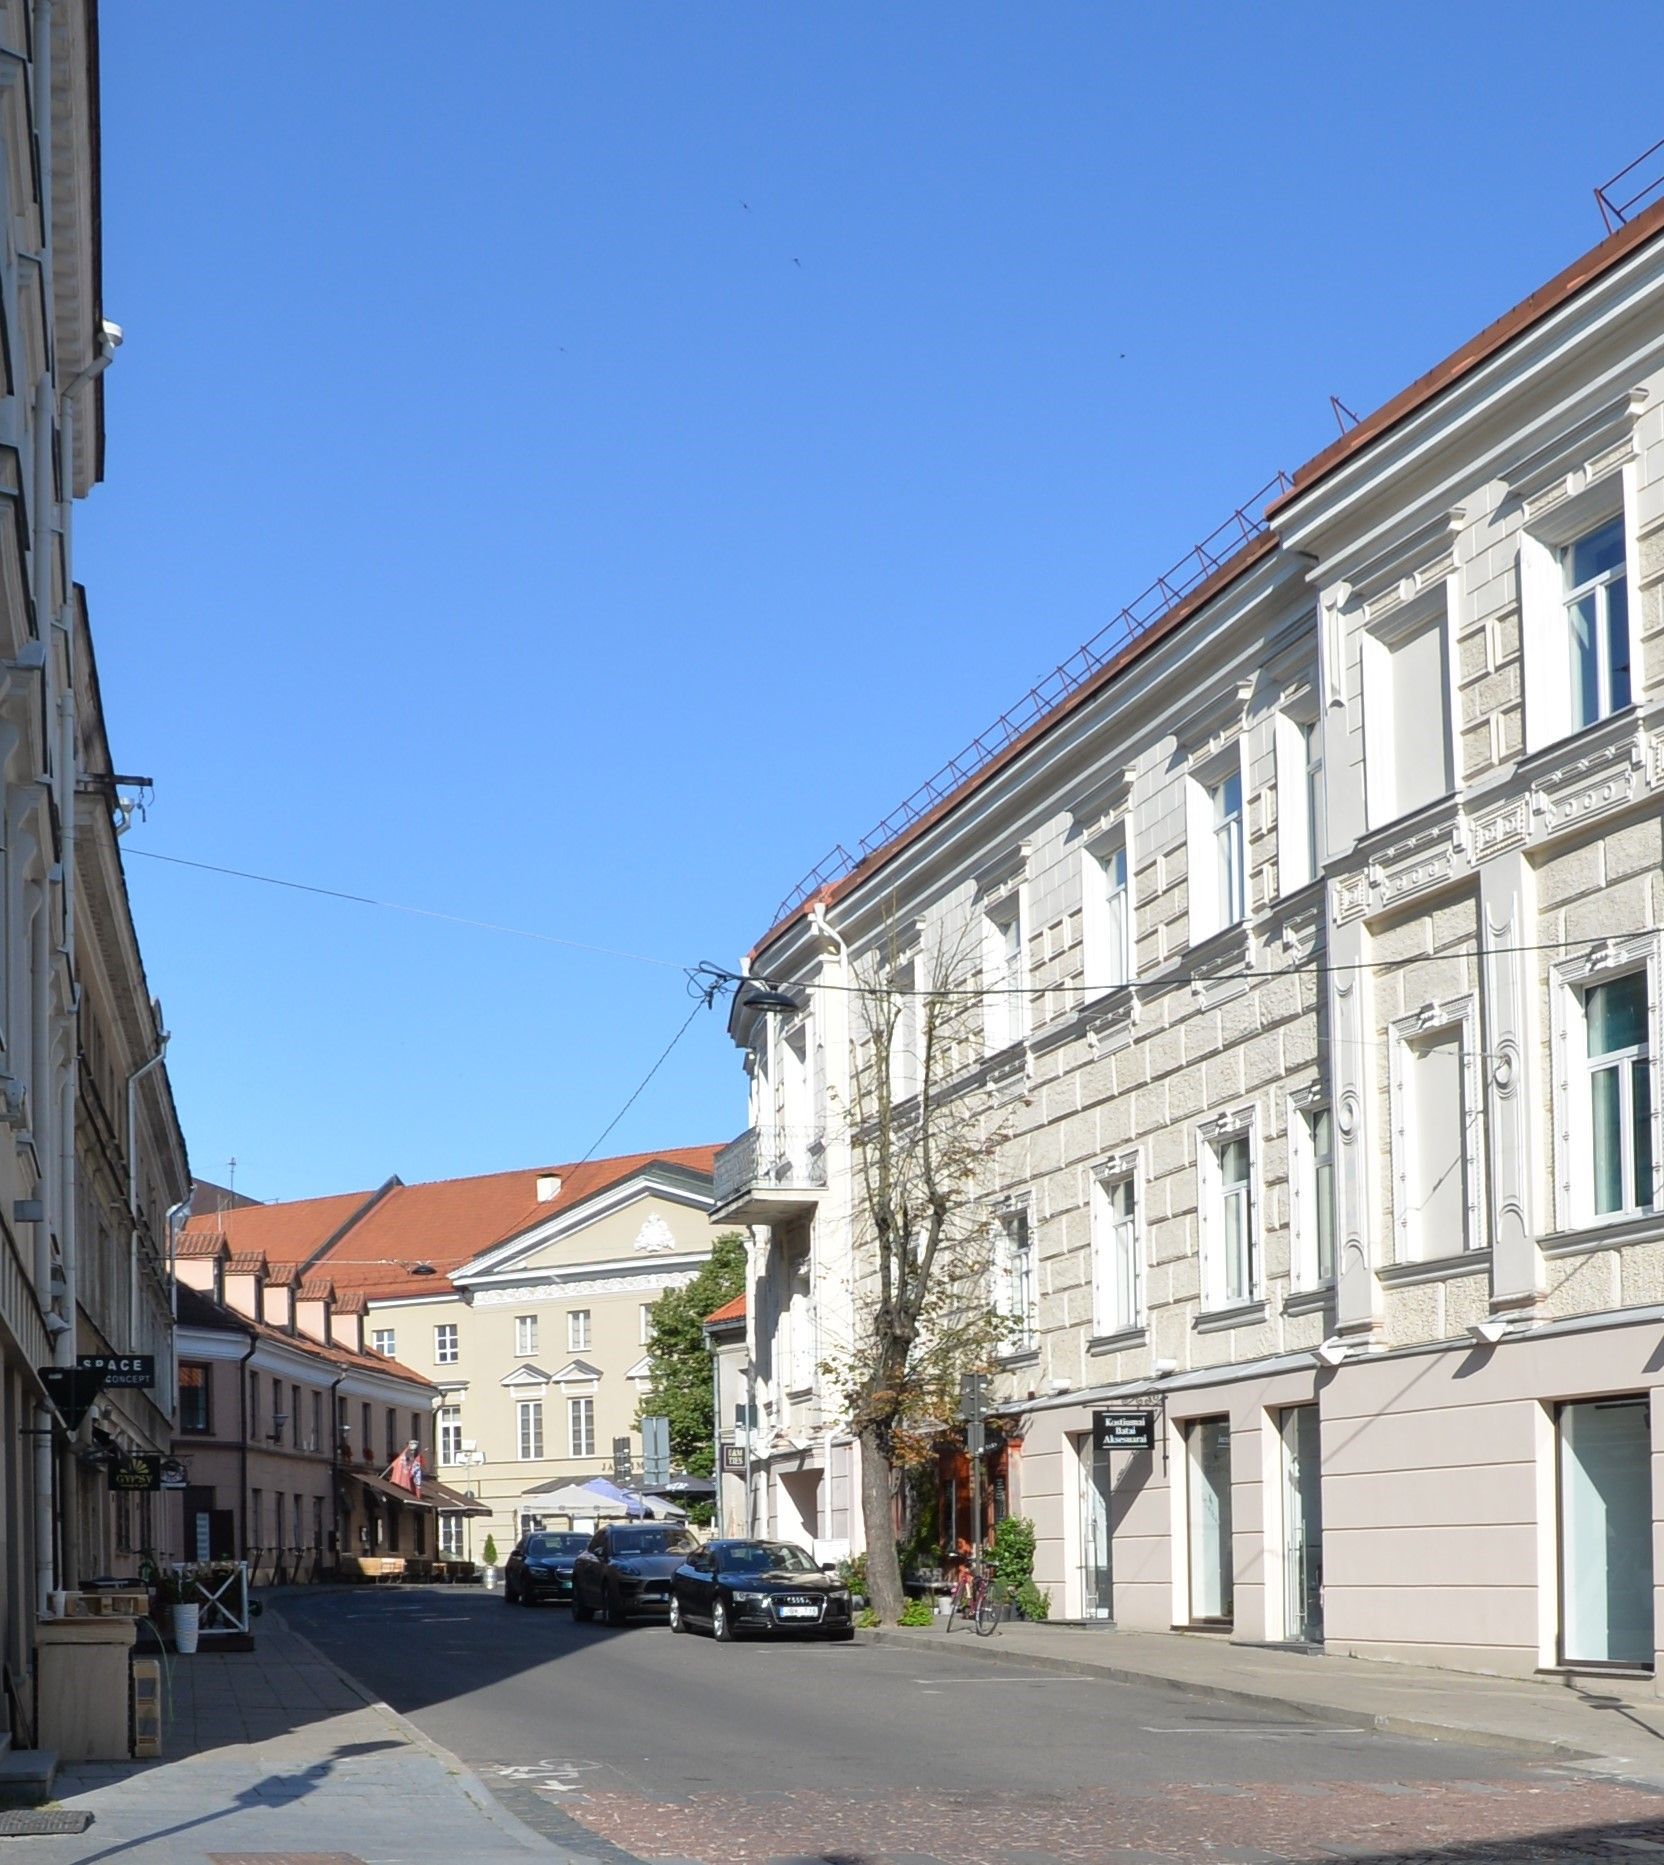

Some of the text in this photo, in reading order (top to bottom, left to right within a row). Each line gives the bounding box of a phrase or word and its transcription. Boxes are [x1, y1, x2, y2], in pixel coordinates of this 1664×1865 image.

[83, 1359, 142, 1371] SPACE
[105, 1375, 151, 1383] CONCEPT
[1115, 1426, 1137, 1435] Batai
[1103, 1434, 1147, 1443] Aksesuarai
[116, 1474, 153, 1484] GYPSY
